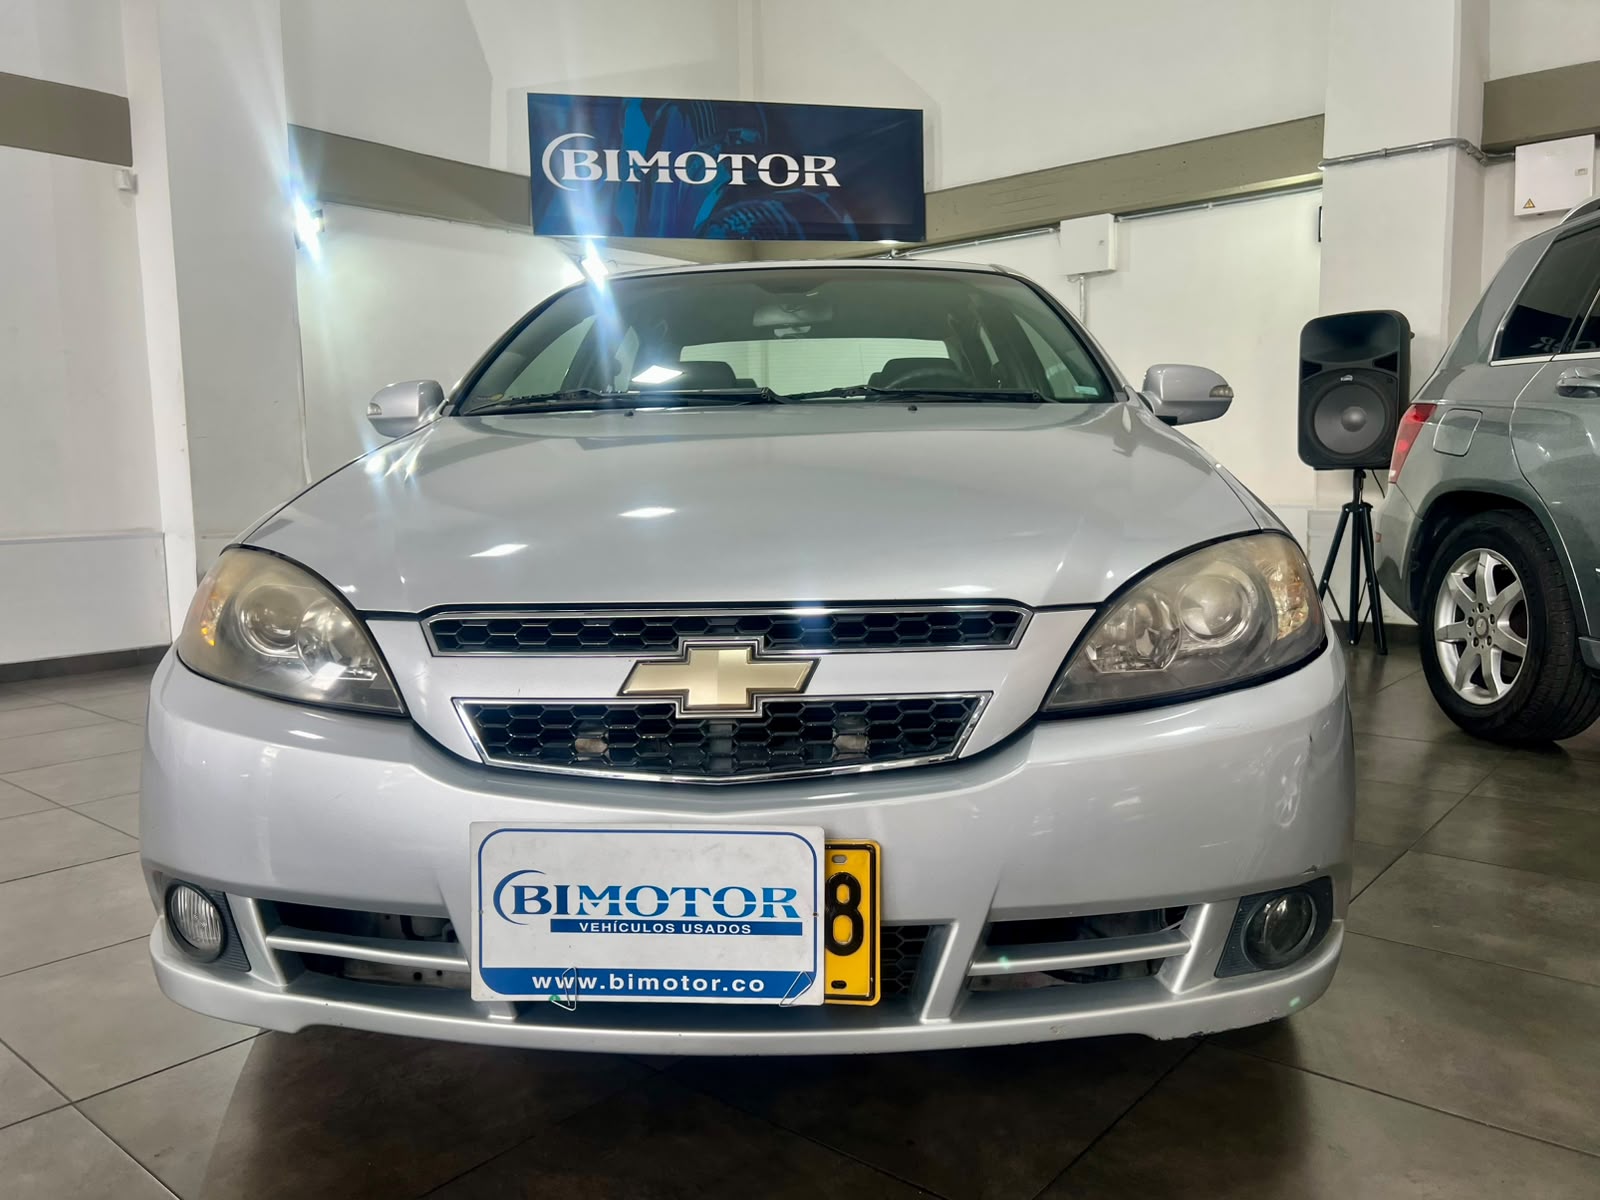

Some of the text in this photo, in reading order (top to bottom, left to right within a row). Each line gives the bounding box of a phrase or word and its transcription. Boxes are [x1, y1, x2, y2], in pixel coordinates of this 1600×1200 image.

[559, 149, 841, 188] BIMOTOR
[510, 883, 802, 919] BIMOTOR
[825, 871, 864, 957] 8
[578, 919, 752, 935] VEHÍCULOS USADOS
[531, 973, 766, 993] www.bimotor.co
